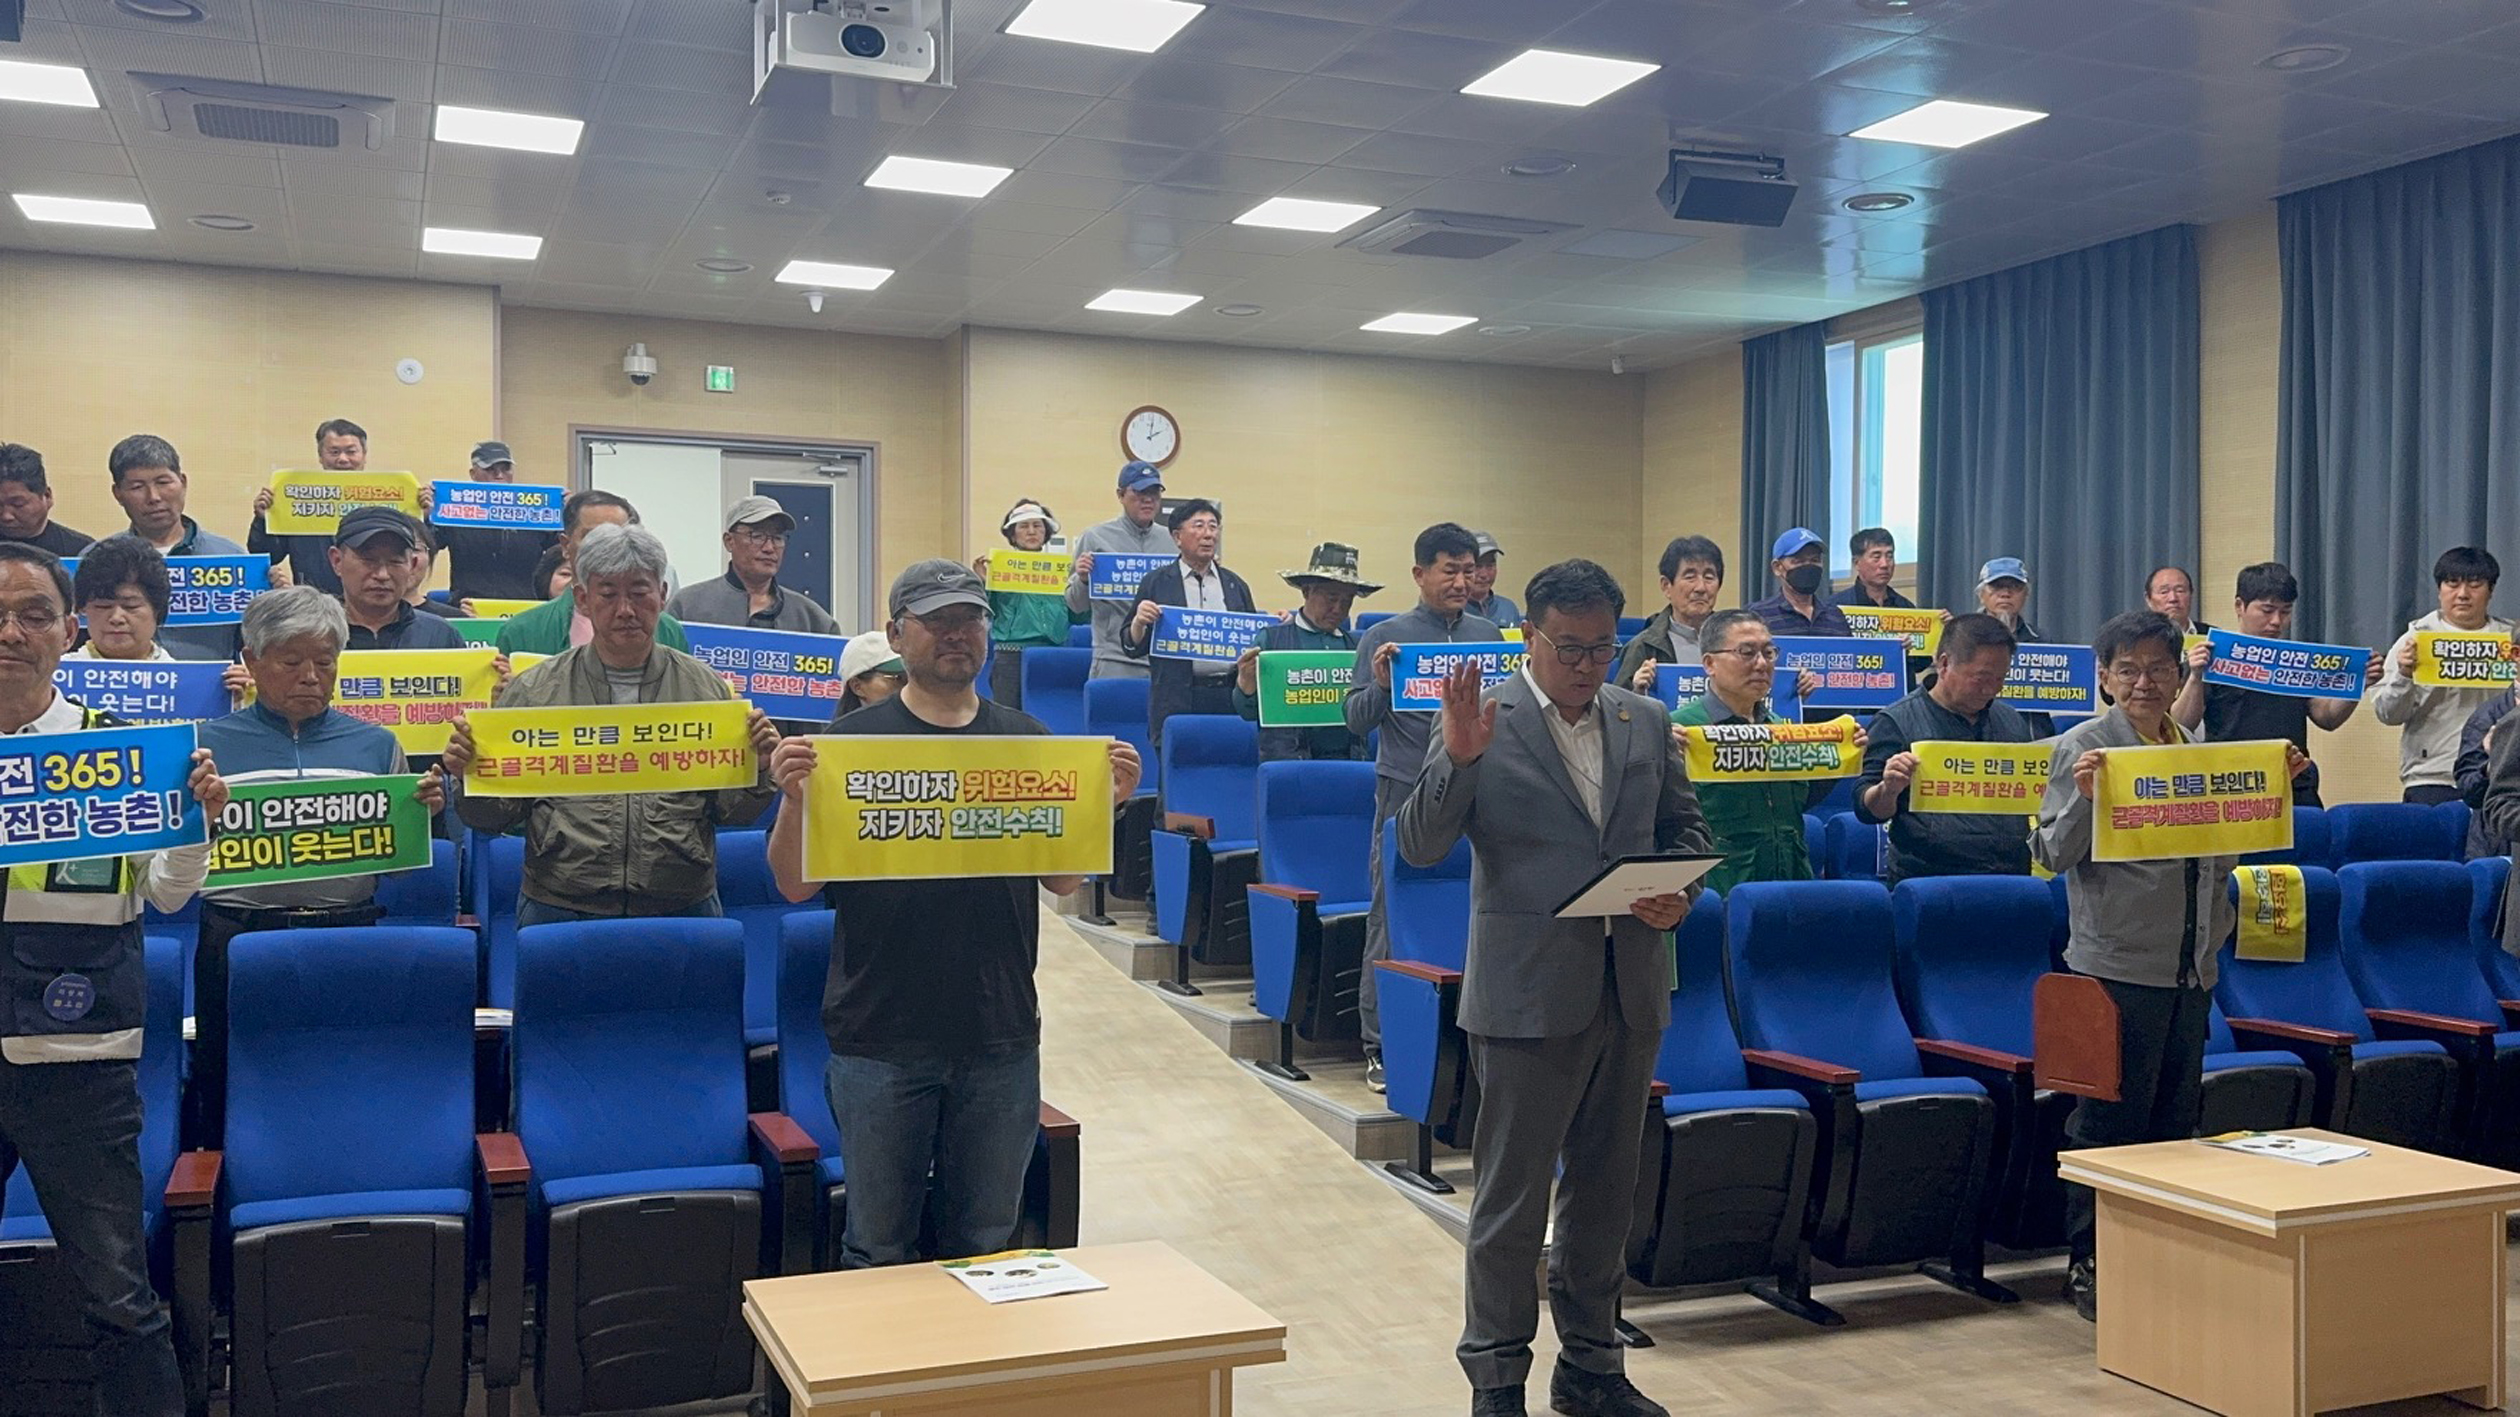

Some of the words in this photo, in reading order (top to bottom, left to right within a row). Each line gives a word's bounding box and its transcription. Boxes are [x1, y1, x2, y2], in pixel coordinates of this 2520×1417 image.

[450, 488, 487, 503] 농업인
[490, 490, 514, 505] 안전
[292, 502, 335, 516] 지키자
[437, 503, 488, 520] 사고없는
[489, 507, 527, 522] 안전한
[1007, 558, 1027, 570] 아는
[1032, 560, 1052, 572] 만큼
[991, 571, 1059, 586] 근골격계질환을
[1111, 571, 1147, 583] 농업인
[1181, 613, 1217, 628] 농촌이
[1845, 614, 1880, 630] 인하자
[1880, 615, 1932, 633] 위험요소!
[1177, 627, 1224, 643] 농업인이
[1155, 639, 1237, 658] 근골격계질환을
[2229, 643, 2277, 664] 농업인
[2279, 650, 2309, 668] 안전
[2433, 639, 2499, 659] 확인하자
[752, 650, 789, 672] 안전
[793, 655, 833, 675] 365!
[1786, 652, 1827, 669] 농업인
[1827, 653, 1854, 670] 안전
[1855, 655, 1884, 670] 365!
[2017, 653, 2069, 668] 안전해야
[84, 668, 179, 690] 안전해야
[1287, 668, 1328, 685] 농촌이
[1826, 672, 1865, 688] 안전한
[1865, 673, 1895, 688] 농촌!
[2028, 668, 2070, 683] 웃는다!
[2209, 657, 2271, 684] 사고없는
[2273, 669, 2318, 688] 안전한
[2440, 661, 2489, 680] 지키자
[339, 677, 385, 699] 만큼
[390, 676, 462, 699] 보인다!
[752, 673, 806, 697] 안전한
[1996, 685, 2036, 700] 질환을
[2036, 686, 2087, 701] 예방하자!
[98, 693, 176, 714] 웃는다!
[1285, 689, 1340, 705] 농업인이
[511, 727, 561, 749] 아는
[573, 725, 621, 747] 만큼
[632, 722, 713, 744] 보인다!
[476, 752, 640, 779] 근골격계질환을
[648, 748, 747, 772] 예방하자!
[1714, 746, 1767, 772] 지키자
[1767, 744, 1840, 770] 안전수칙!
[1943, 758, 1976, 775] 아는
[1983, 759, 2015, 776] 만큼
[845, 770, 959, 803] 확인하자
[962, 770, 1078, 804] 위험요소!
[1919, 780, 2027, 800] 근골격계질환을
[2134, 776, 2169, 800] 아는
[2172, 773, 2208, 797] 만큼
[2210, 770, 2267, 795] 보인다!
[260, 791, 389, 830] 안전해야
[2111, 800, 2220, 830] 근골격계질환을
[858, 807, 944, 840] 지키자
[948, 805, 1064, 839] 안전수칙!
[290, 826, 395, 866] 웃는다!
